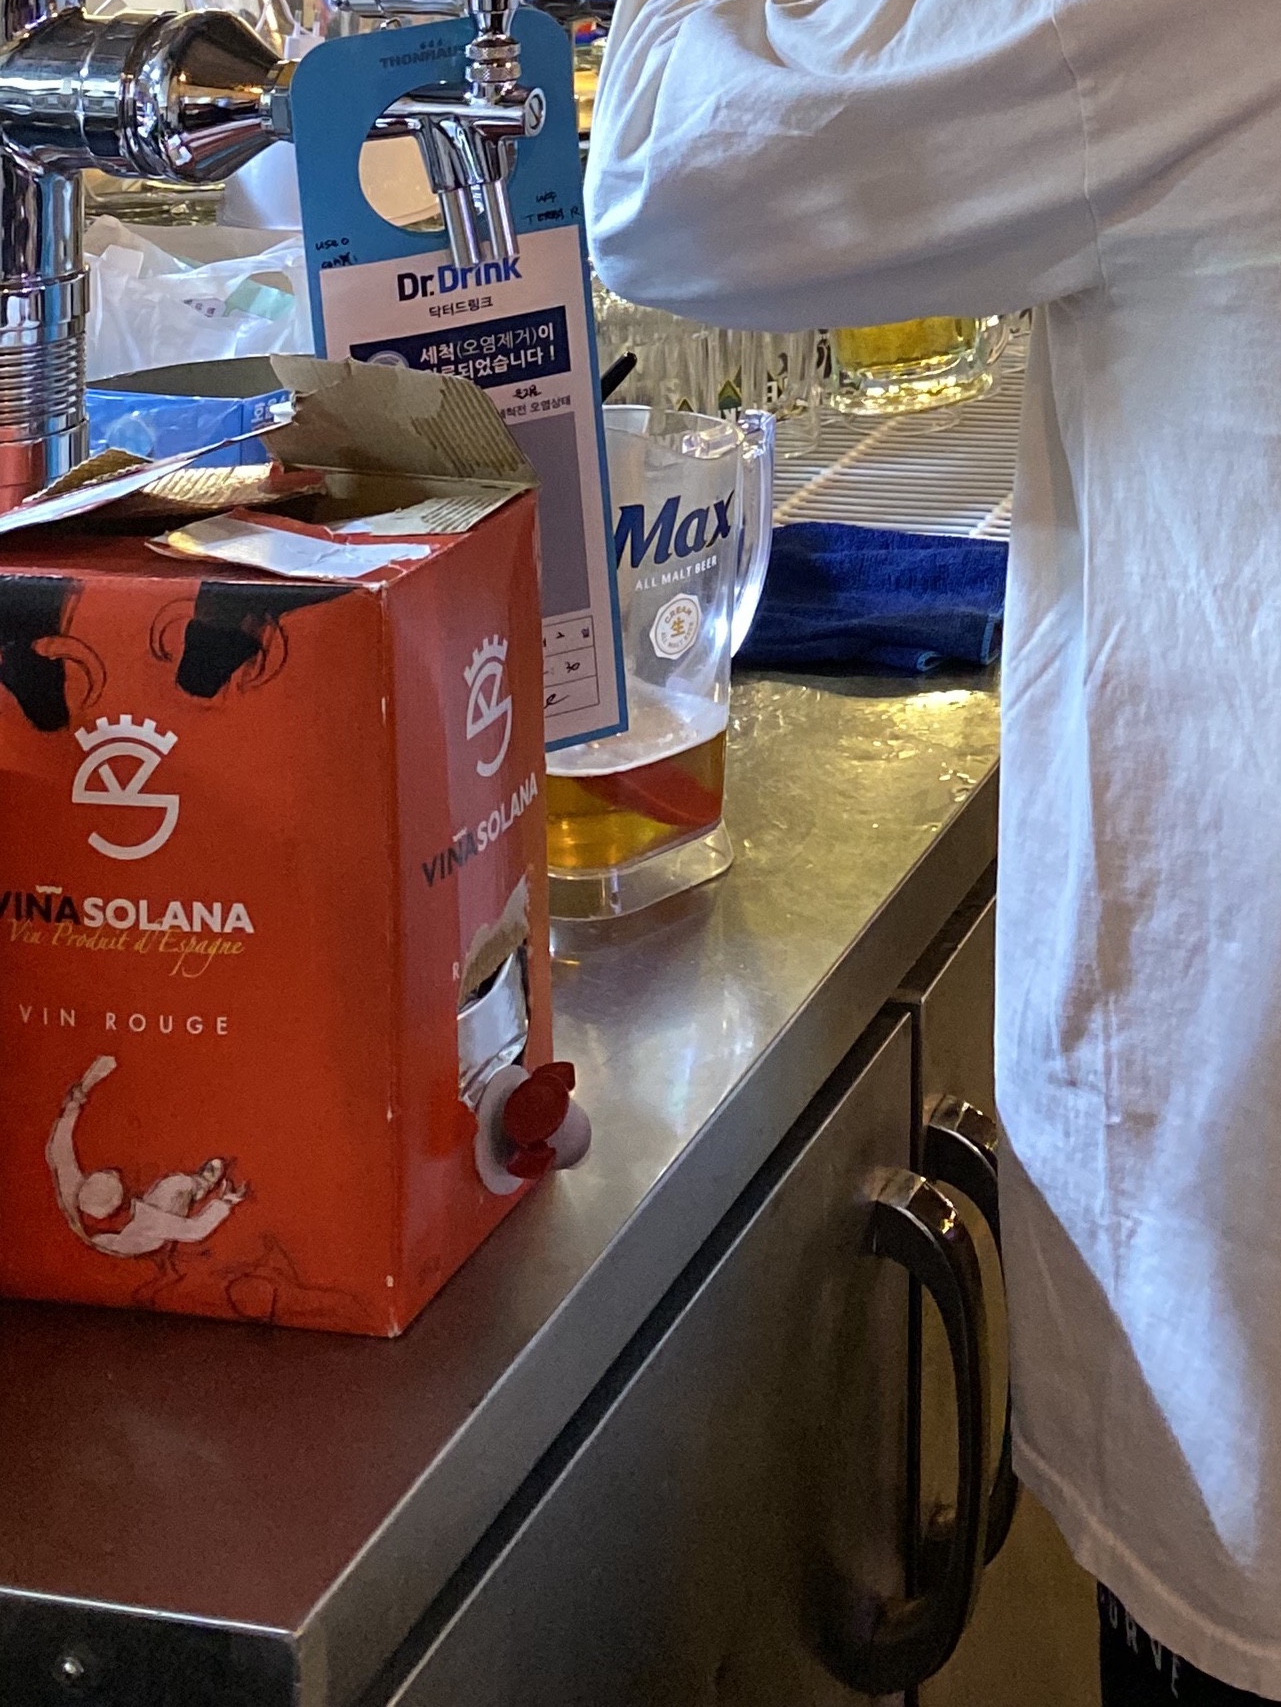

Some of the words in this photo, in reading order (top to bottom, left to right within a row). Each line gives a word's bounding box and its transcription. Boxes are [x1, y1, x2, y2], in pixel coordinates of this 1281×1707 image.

[428, 295, 494, 319] 닥터드링크
[613, 489, 735, 570] Max
[635, 577, 657, 592] ALL
[661, 565, 693, 585] MALT
[694, 554, 718, 574] BEER
[19, 1003, 76, 1028] VIN
[105, 1011, 229, 1036] ROUGE
